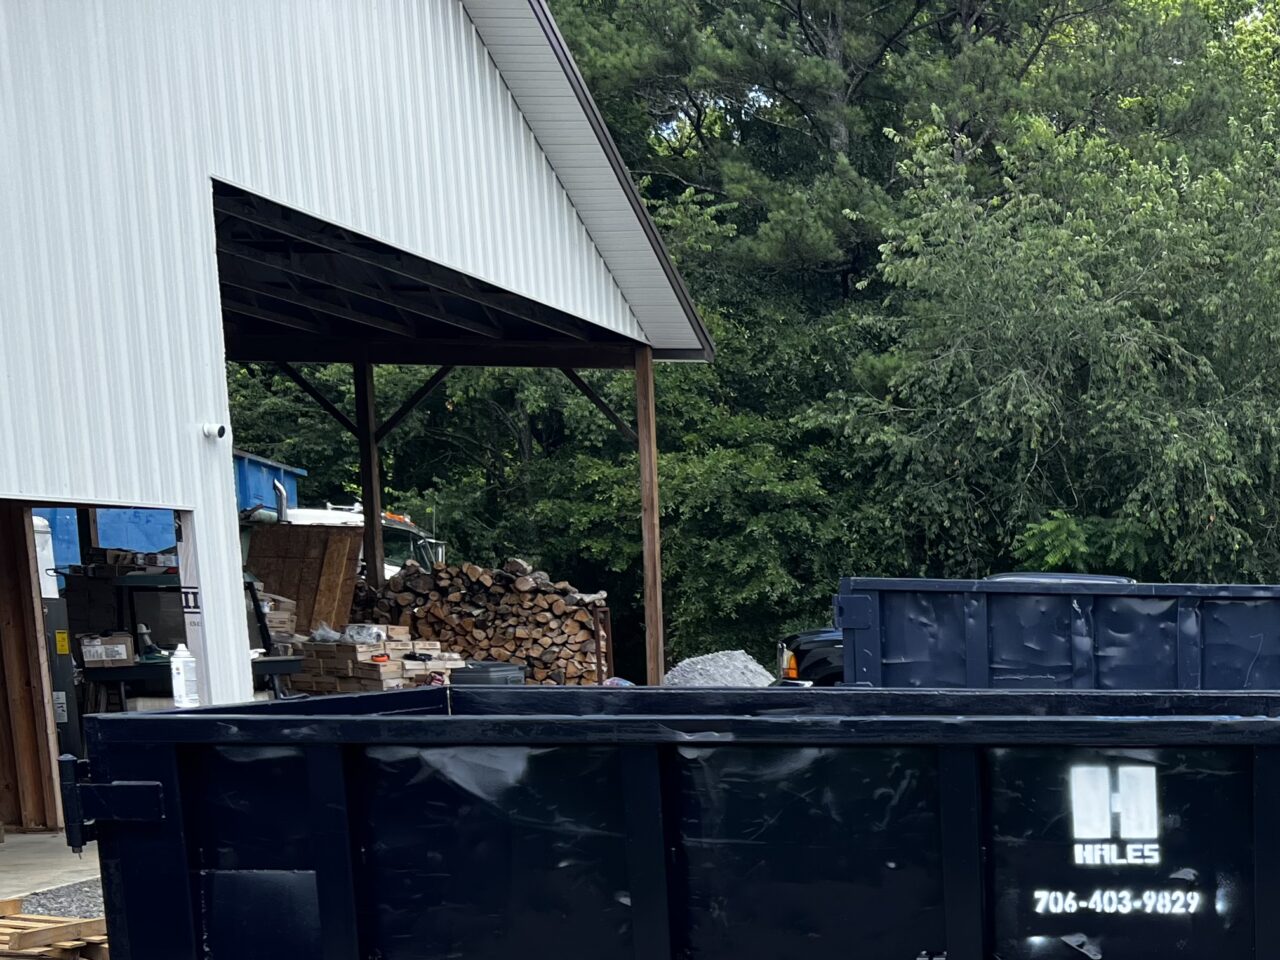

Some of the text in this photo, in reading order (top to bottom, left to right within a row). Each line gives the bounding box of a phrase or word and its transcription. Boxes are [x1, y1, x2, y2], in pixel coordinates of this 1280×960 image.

[1070, 766, 1159, 839] H
[1073, 843, 1160, 865] HALES
[1033, 889, 1201, 915] 706-403-9829
